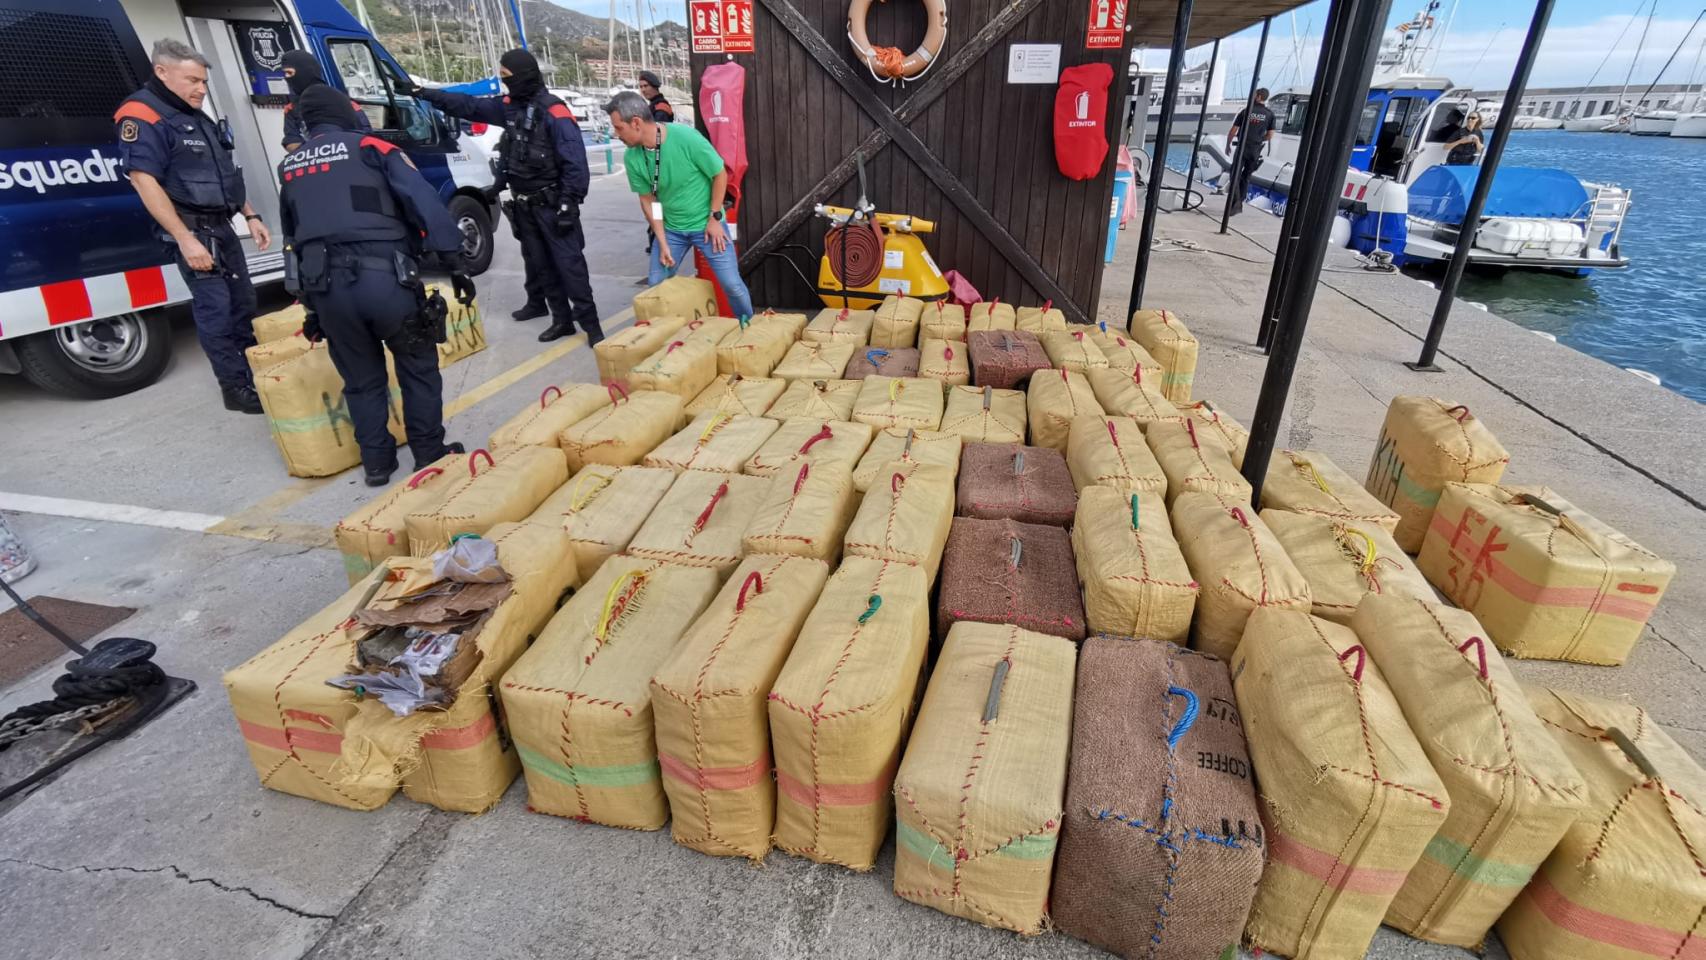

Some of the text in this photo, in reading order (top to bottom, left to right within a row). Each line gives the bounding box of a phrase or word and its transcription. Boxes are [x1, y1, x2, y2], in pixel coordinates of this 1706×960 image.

[284, 142, 348, 166] POLICIA
[0, 149, 131, 194] squadr
[1198, 751, 1248, 779] COFFEE
